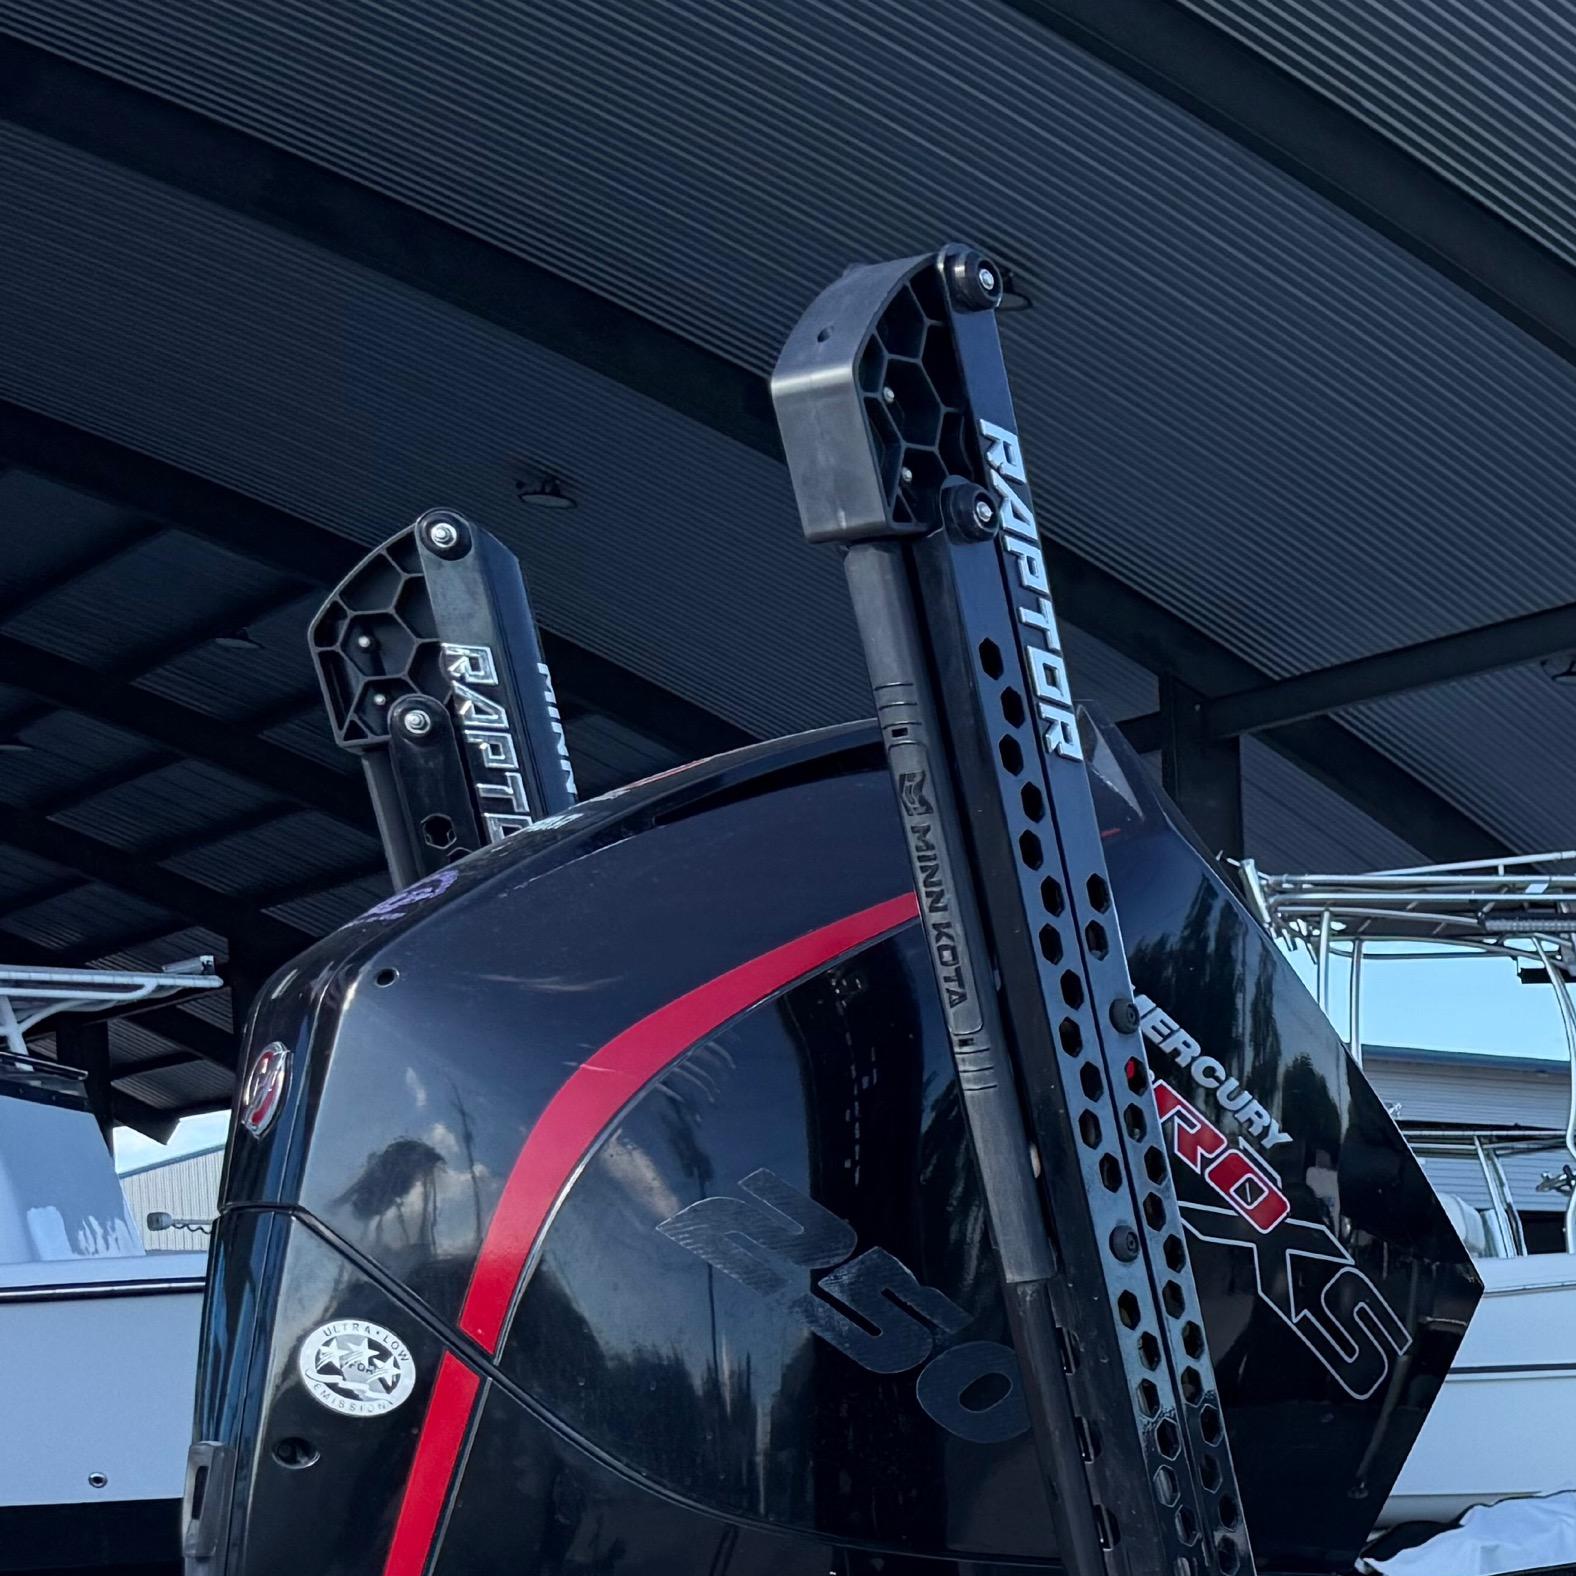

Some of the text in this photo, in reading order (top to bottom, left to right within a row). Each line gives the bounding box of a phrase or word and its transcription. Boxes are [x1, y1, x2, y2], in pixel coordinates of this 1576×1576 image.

[980, 418, 1084, 762] RAPTOR
[910, 824, 968, 1009] MINN KOTA
[1153, 1079, 1291, 1234] RO
[383, 1335, 409, 1362] LOW
[655, 1168, 1034, 1443] 250
